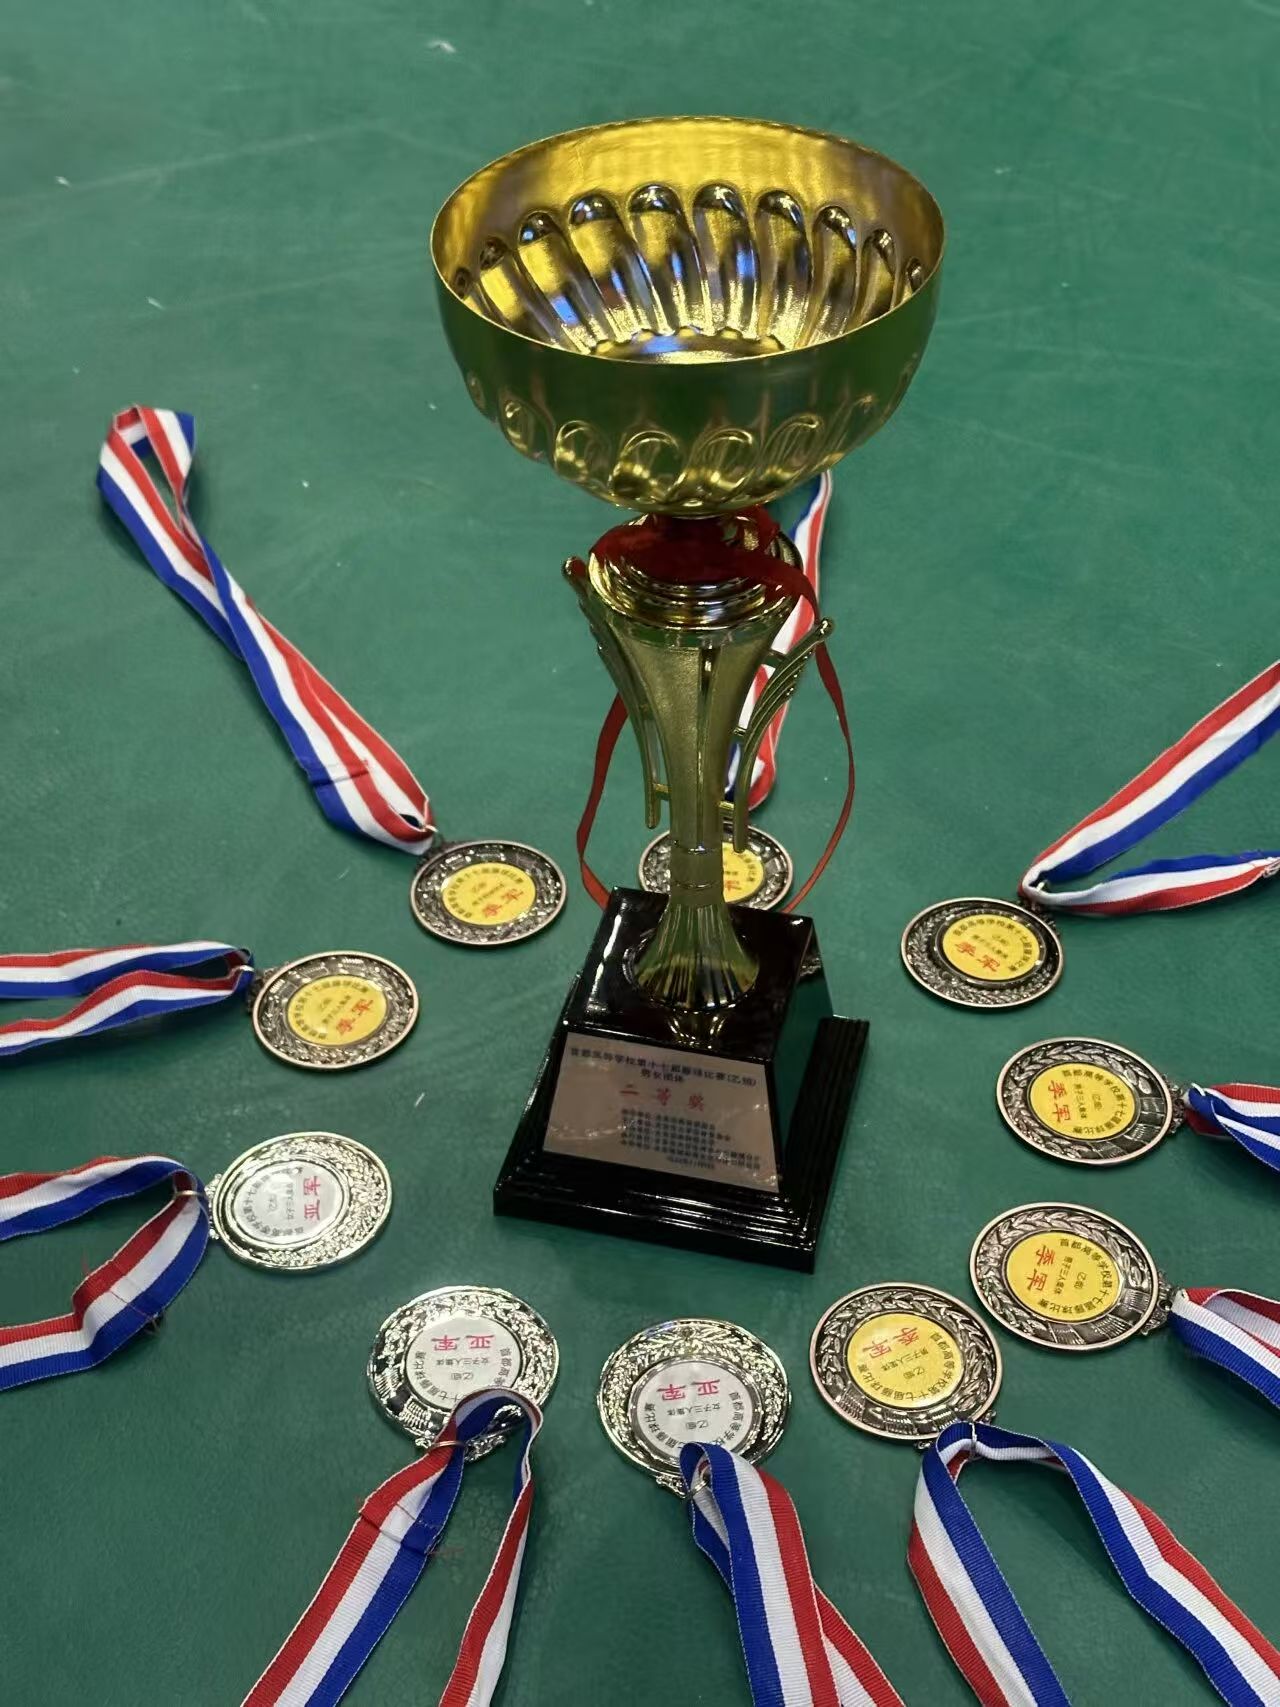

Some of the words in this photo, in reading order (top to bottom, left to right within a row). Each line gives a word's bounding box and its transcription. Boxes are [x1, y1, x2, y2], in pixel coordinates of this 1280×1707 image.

[724, 880, 742, 892] 军
[955, 942, 1000, 972] 季军
[1048, 1080, 1070, 1123] 季军
[303, 1176, 320, 1220] 亚军
[1025, 1245, 1055, 1291] 季军
[431, 1335, 494, 1351] 亚军
[862, 1327, 919, 1358] 季军
[436, 1357, 489, 1367] 女子三人集体
[657, 1379, 720, 1401] 亚军
[667, 1402, 721, 1415] 女子三人集体
